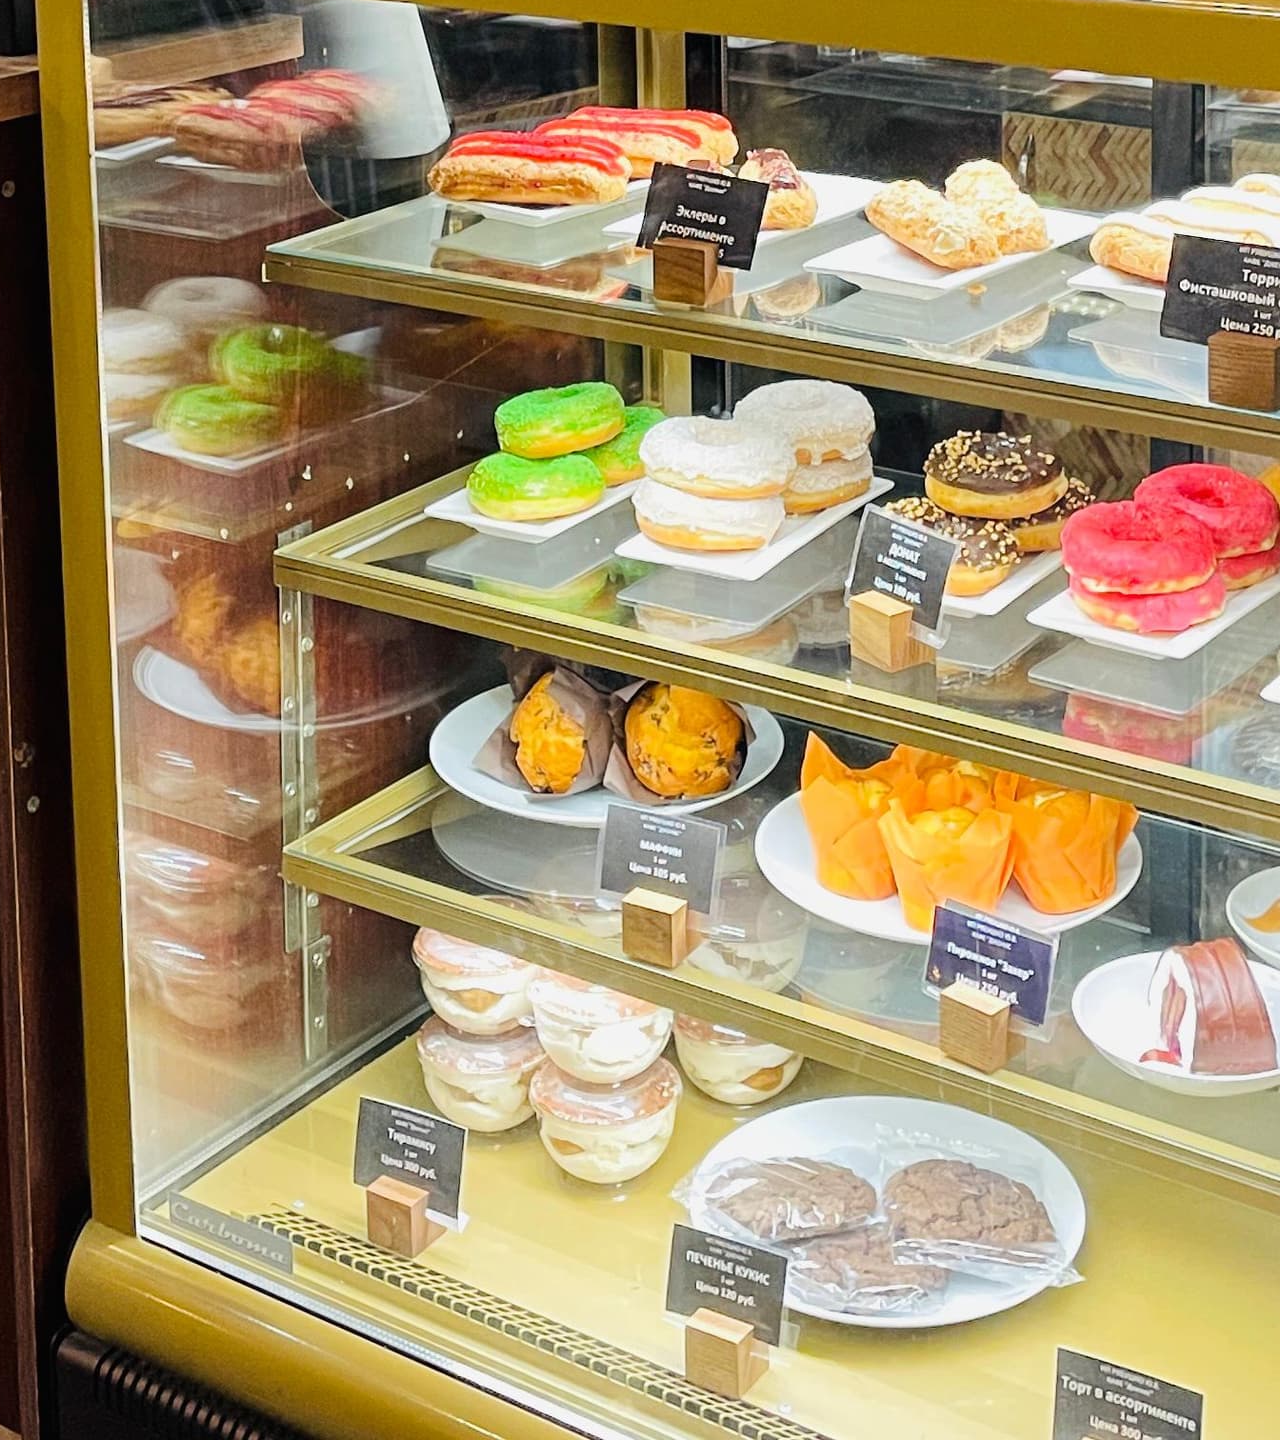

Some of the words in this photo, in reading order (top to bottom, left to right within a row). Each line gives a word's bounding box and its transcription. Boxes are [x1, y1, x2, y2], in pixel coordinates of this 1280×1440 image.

[676, 204, 717, 224] Эклеры
[1179, 278, 1275, 308] Фисташковый
[1220, 317, 1250, 334] Цена
[1252, 322, 1274, 337] 250
[172, 1201, 288, 1265] Carboma
[686, 1250, 734, 1275] ПЕЧЕНЬЕ
[1061, 1374, 1092, 1397] Торт
[1105, 1390, 1196, 1433] ассортименте
[1089, 1415, 1119, 1435] Цена
